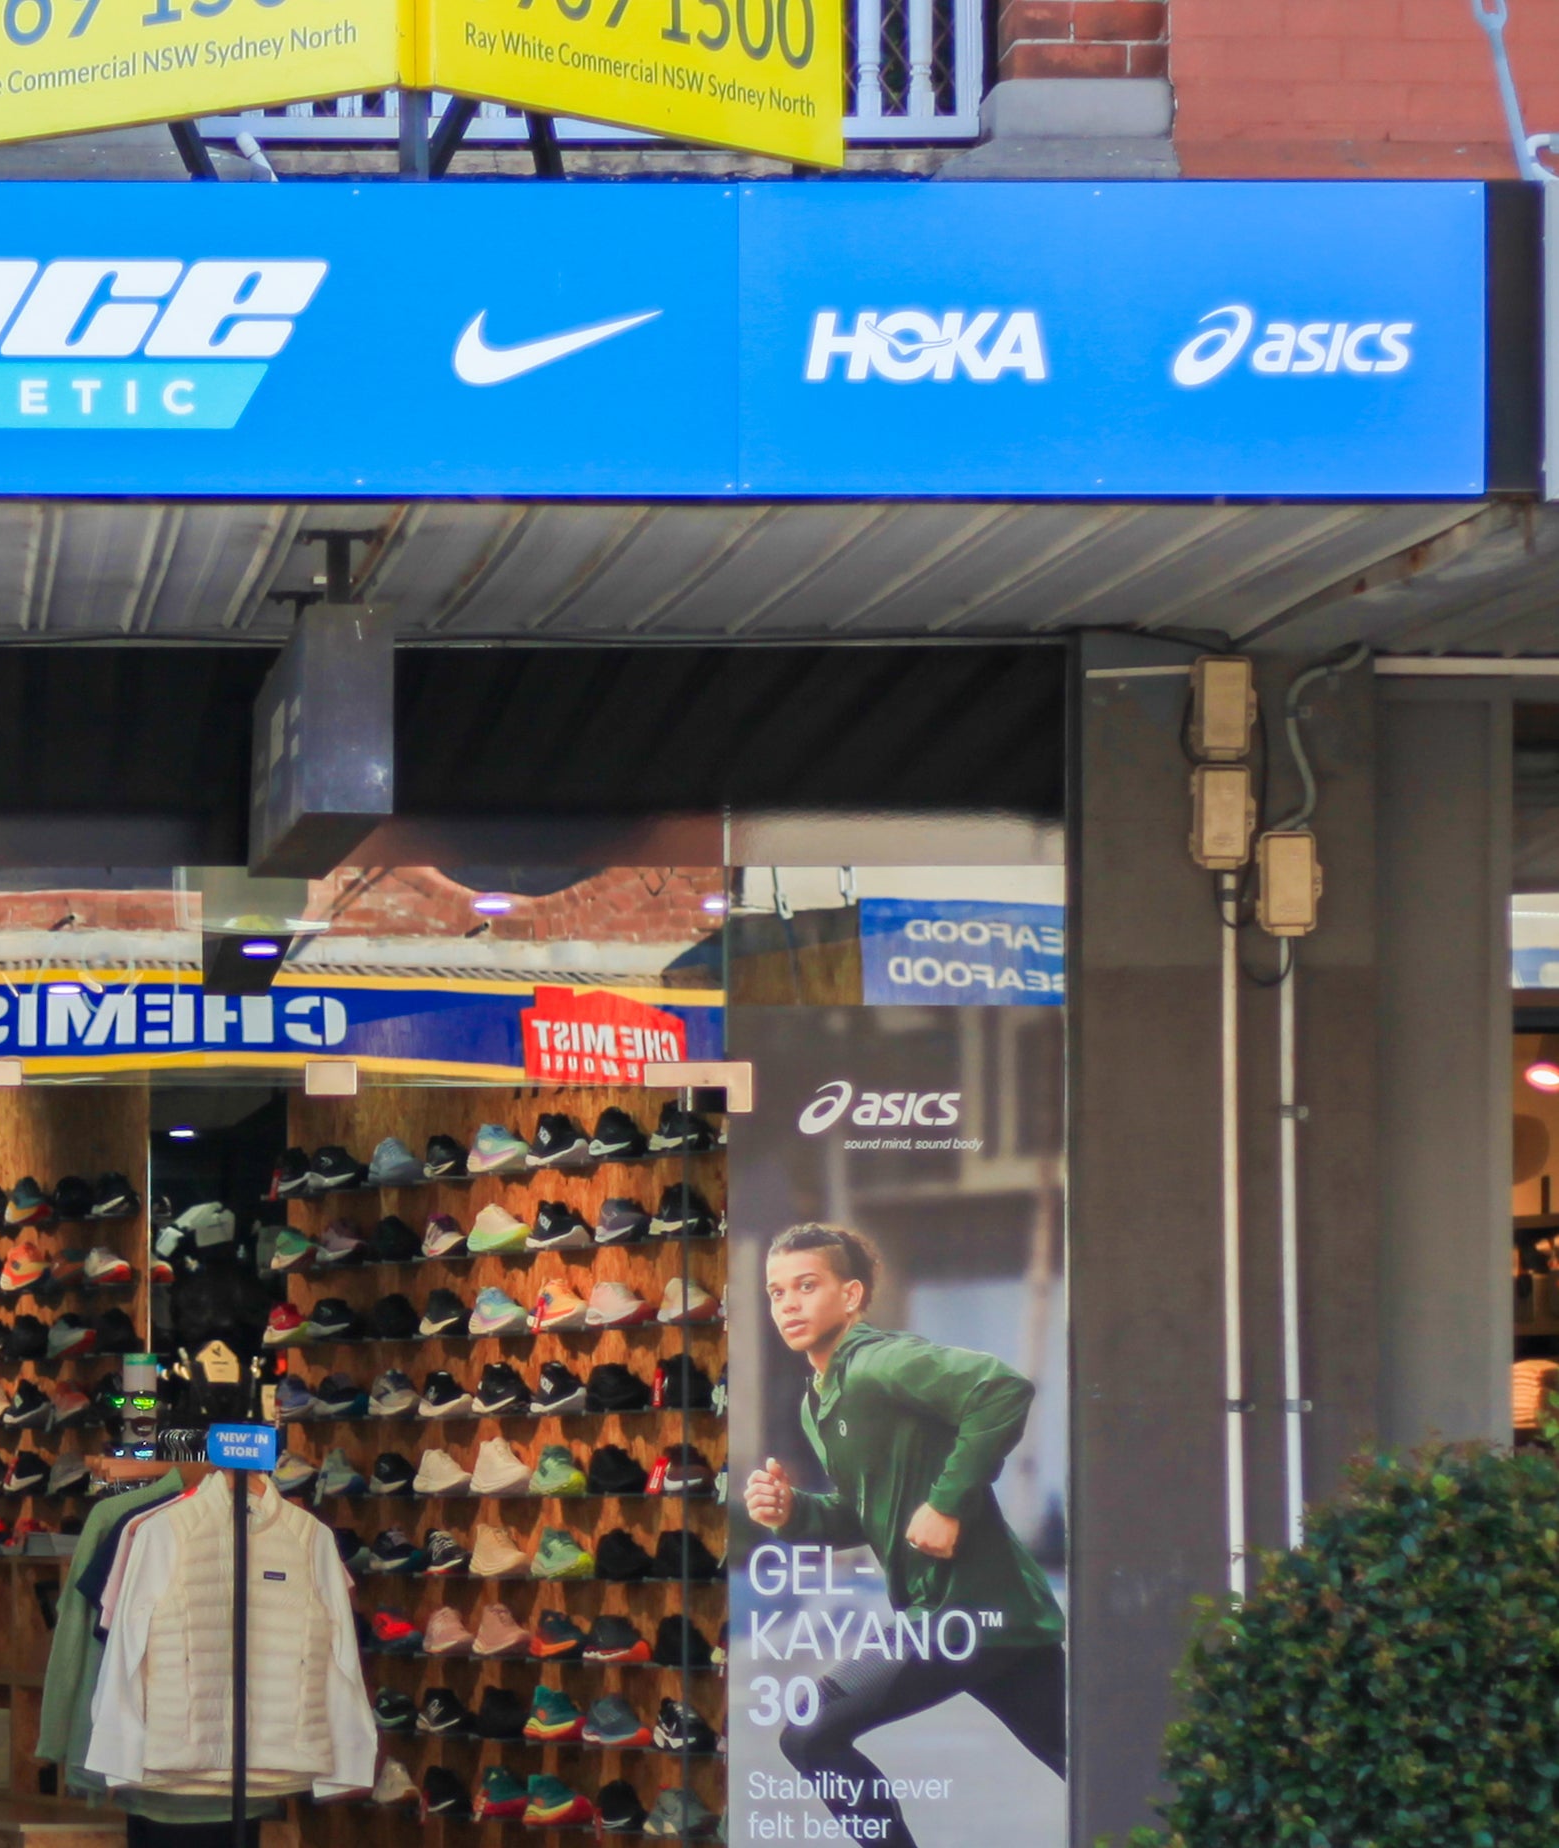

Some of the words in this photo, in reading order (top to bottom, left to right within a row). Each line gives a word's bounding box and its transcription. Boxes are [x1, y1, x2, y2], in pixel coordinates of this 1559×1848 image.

[8, 52, 137, 94] Commercial
[143, 43, 199, 74] NSW
[205, 36, 284, 68] Sydney
[291, 19, 357, 52] North
[465, 21, 497, 55] Ray
[501, 29, 554, 63] White
[559, 42, 658, 85] Commercial
[663, 64, 704, 94] NSW
[708, 73, 766, 111] Sydney
[770, 87, 816, 119] North
[805, 310, 1046, 382] HOKA
[1252, 322, 1413, 373] asics
[852, 1092, 961, 1126] asics
[844, 1138, 881, 1150] sound
[881, 1137, 913, 1151] mind,
[915, 1138, 952, 1150] sound
[953, 1138, 984, 1152] body
[223, 1446, 259, 1458] STORE
[254, 1434, 269, 1445] IN
[749, 1544, 875, 1597] GEL-
[748, 1675, 820, 1727] 30
[748, 1771, 865, 1806] Stability
[873, 1777, 953, 1800] never
[748, 1811, 794, 1840] felt
[804, 1811, 891, 1840] better
